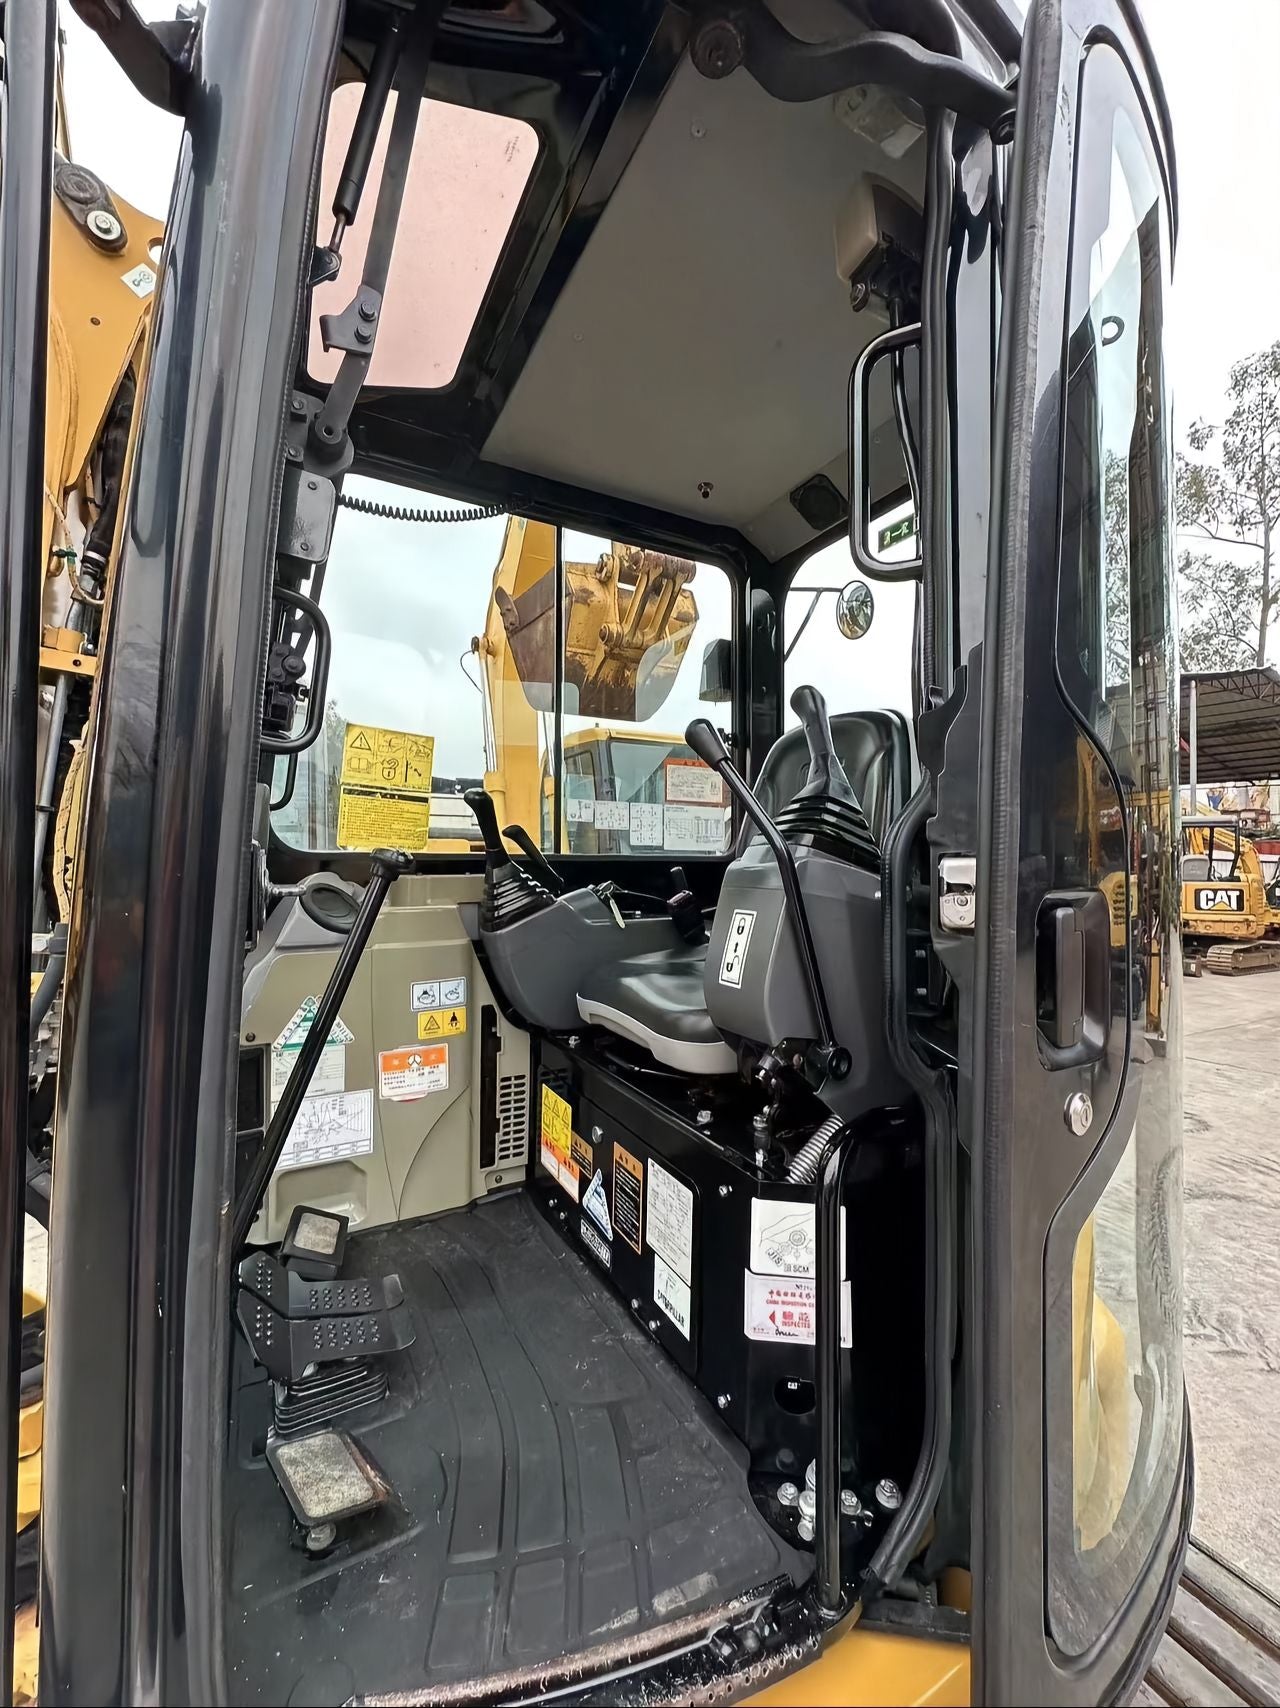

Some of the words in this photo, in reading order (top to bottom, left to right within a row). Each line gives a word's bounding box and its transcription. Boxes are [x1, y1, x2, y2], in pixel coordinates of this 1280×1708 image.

[1199, 890, 1240, 911] CAT
[767, 1250, 782, 1265] JIS
[793, 1264, 810, 1273] SCM
